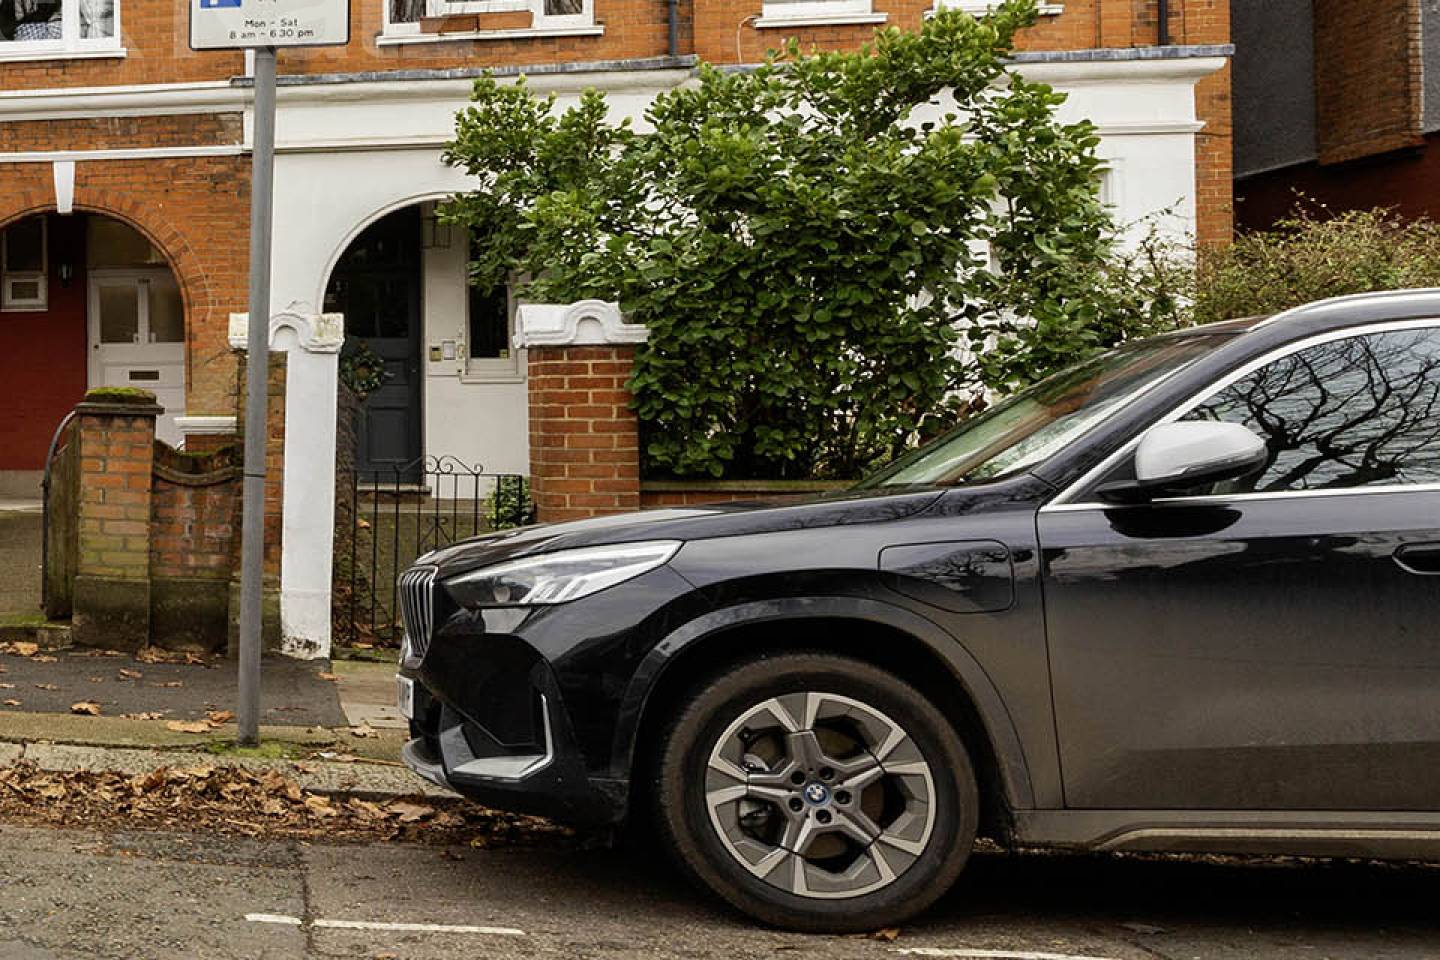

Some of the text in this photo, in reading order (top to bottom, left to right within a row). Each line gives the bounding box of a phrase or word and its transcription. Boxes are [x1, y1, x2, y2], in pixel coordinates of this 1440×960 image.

[244, 20, 266, 28] Mon
[280, 18, 298, 28] Sat
[229, 30, 237, 40] 8
[297, 29, 314, 38] pm
